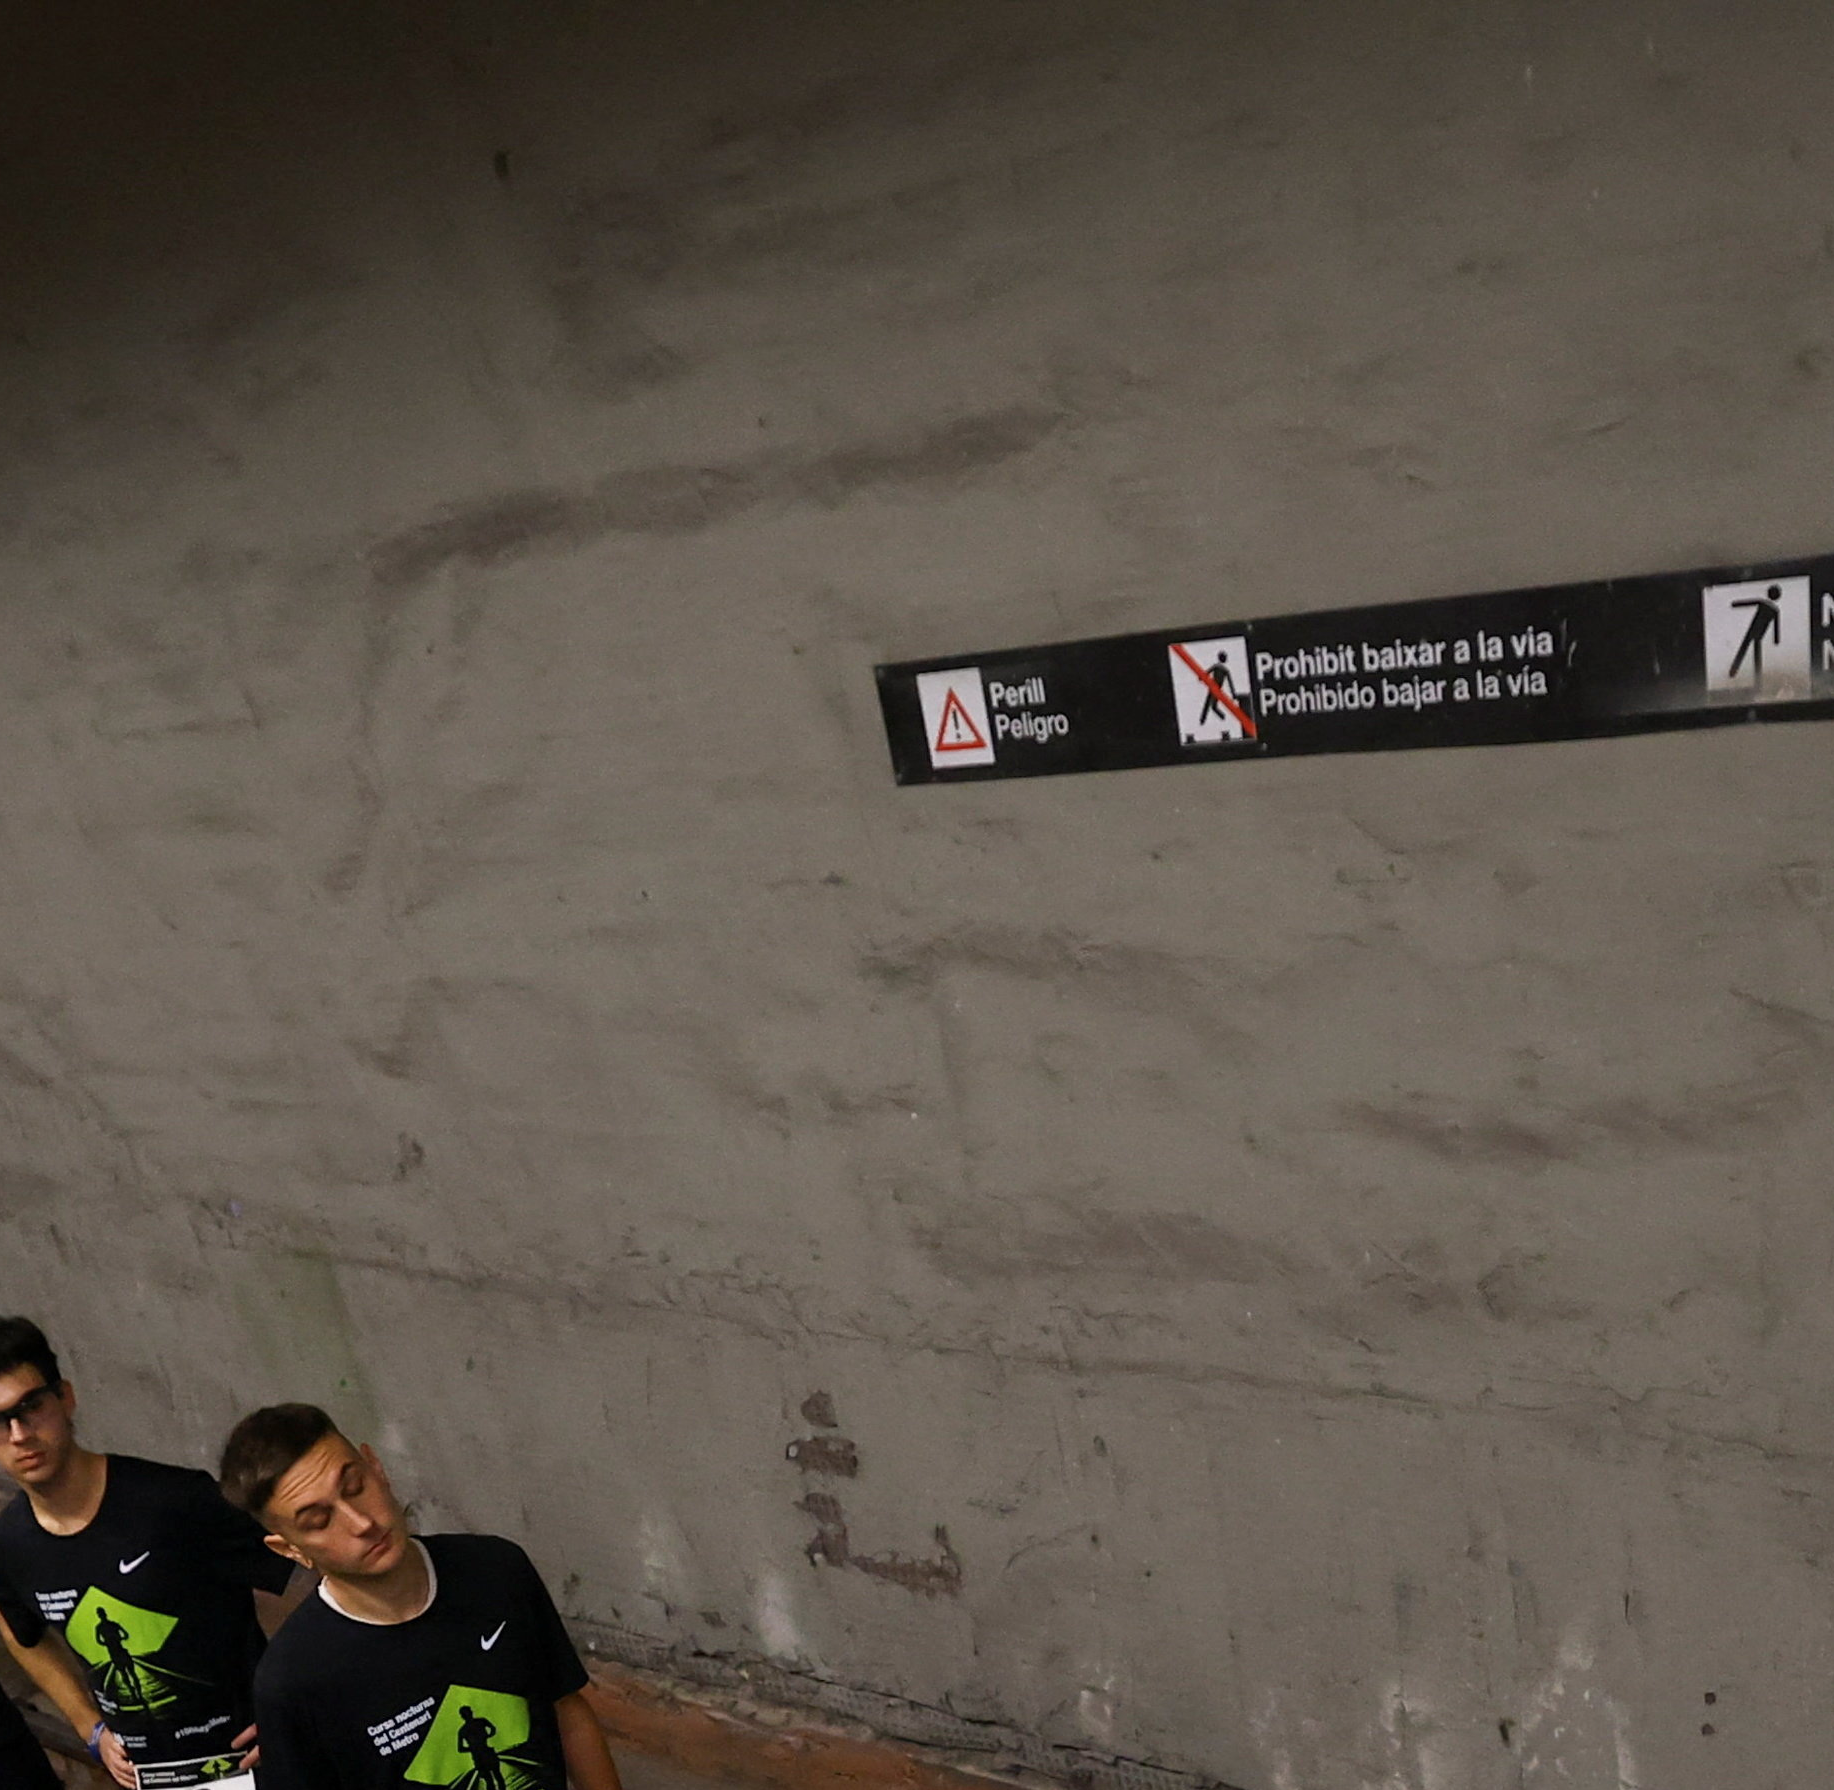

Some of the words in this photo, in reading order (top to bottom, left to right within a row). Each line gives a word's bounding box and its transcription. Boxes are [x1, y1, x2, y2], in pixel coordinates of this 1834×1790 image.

[1255, 648, 1357, 681] Prohibit
[1362, 637, 1444, 671] baixar
[1453, 640, 1470, 664] a
[1479, 632, 1504, 662] la
[989, 677, 1047, 709] Perill
[1259, 679, 1377, 716] Prohibido
[1382, 672, 1447, 709] bajar
[1453, 676, 1471, 700] a
[1477, 669, 1501, 698] la
[1508, 666, 1548, 697] vía
[994, 710, 1069, 744] Peligro
[367, 1718, 396, 1737] Cursa
[395, 1696, 435, 1724] nocturna
[373, 1732, 389, 1747] del
[388, 1710, 433, 1739] Centenari
[391, 1732, 420, 1751] Metro
